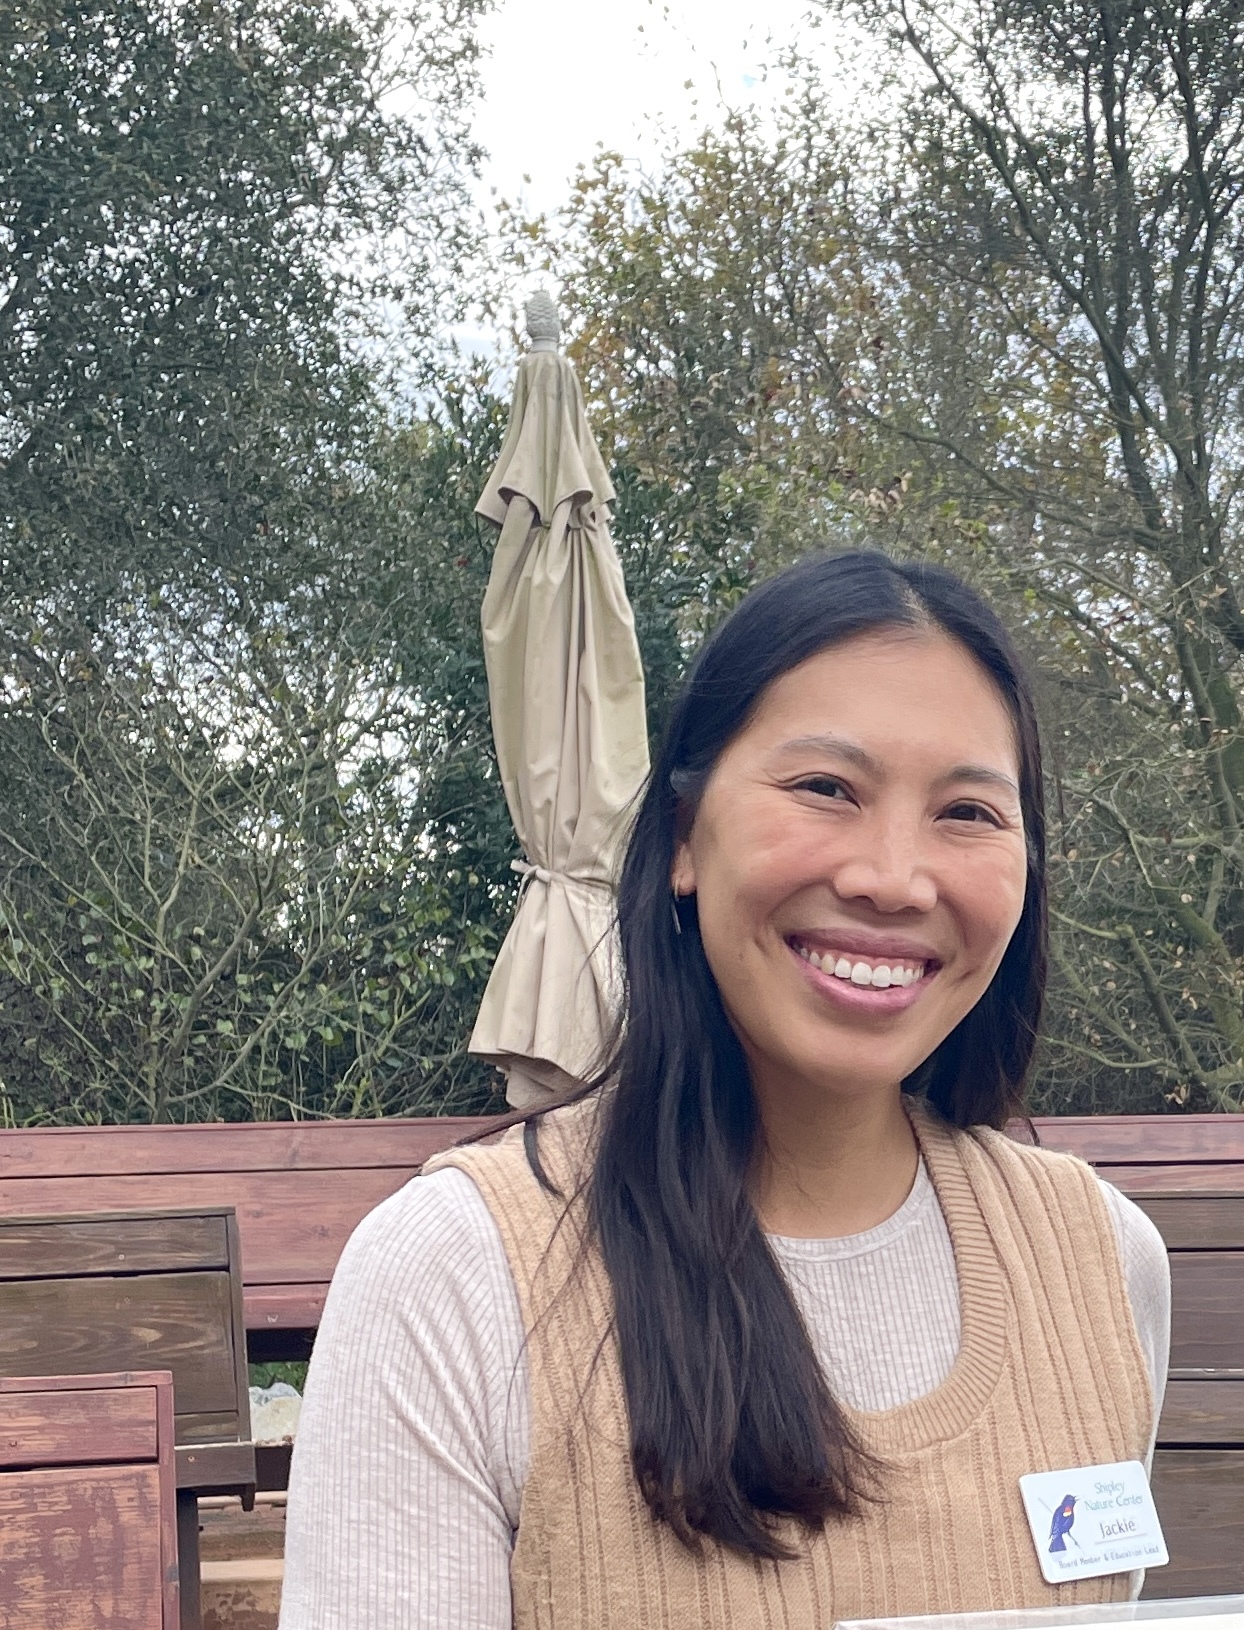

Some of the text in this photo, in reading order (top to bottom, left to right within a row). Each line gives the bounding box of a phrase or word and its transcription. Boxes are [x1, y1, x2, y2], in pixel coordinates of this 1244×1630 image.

[1094, 1481, 1125, 1497] Shipley
[1084, 1497, 1114, 1511] Nature
[1099, 1519, 1137, 1539] Jackie
